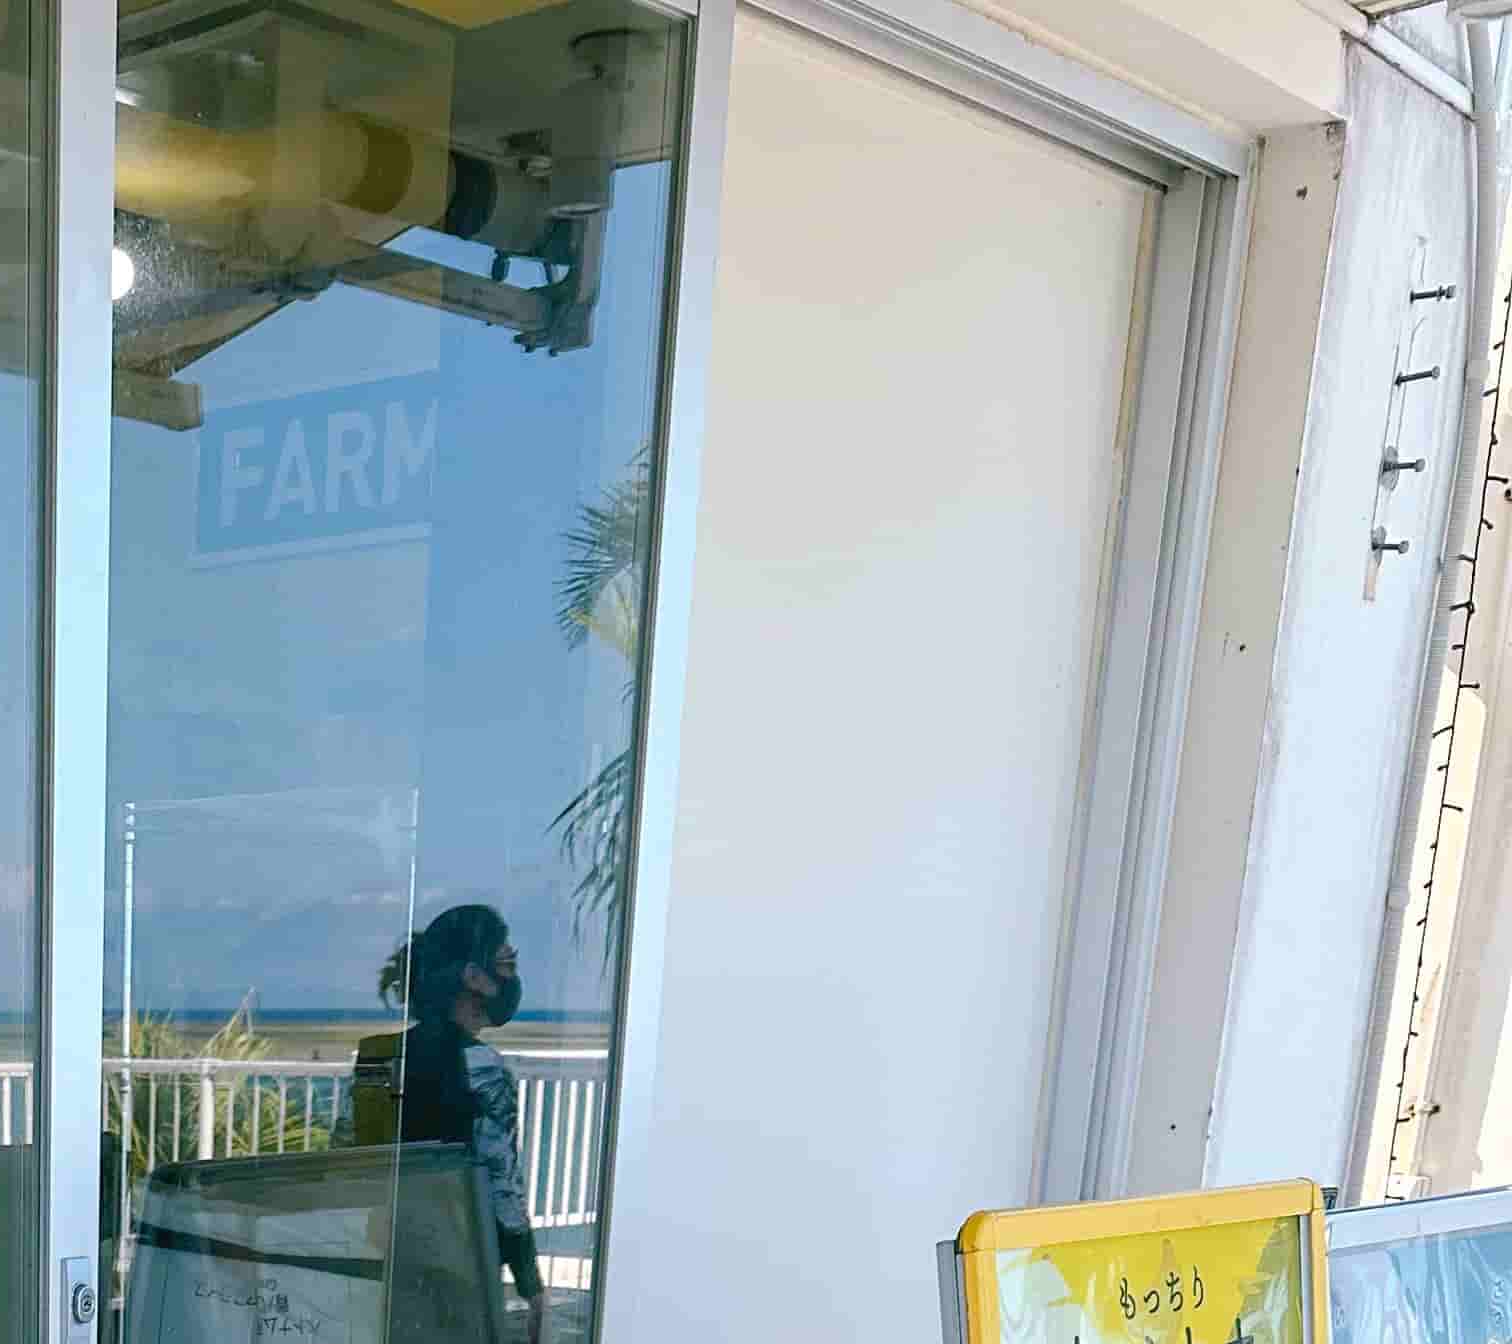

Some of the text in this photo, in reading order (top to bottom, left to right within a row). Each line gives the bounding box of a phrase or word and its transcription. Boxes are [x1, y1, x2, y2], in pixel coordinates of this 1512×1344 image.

[219, 399, 439, 529] FARM
[1119, 1264, 1205, 1321] もっちり
